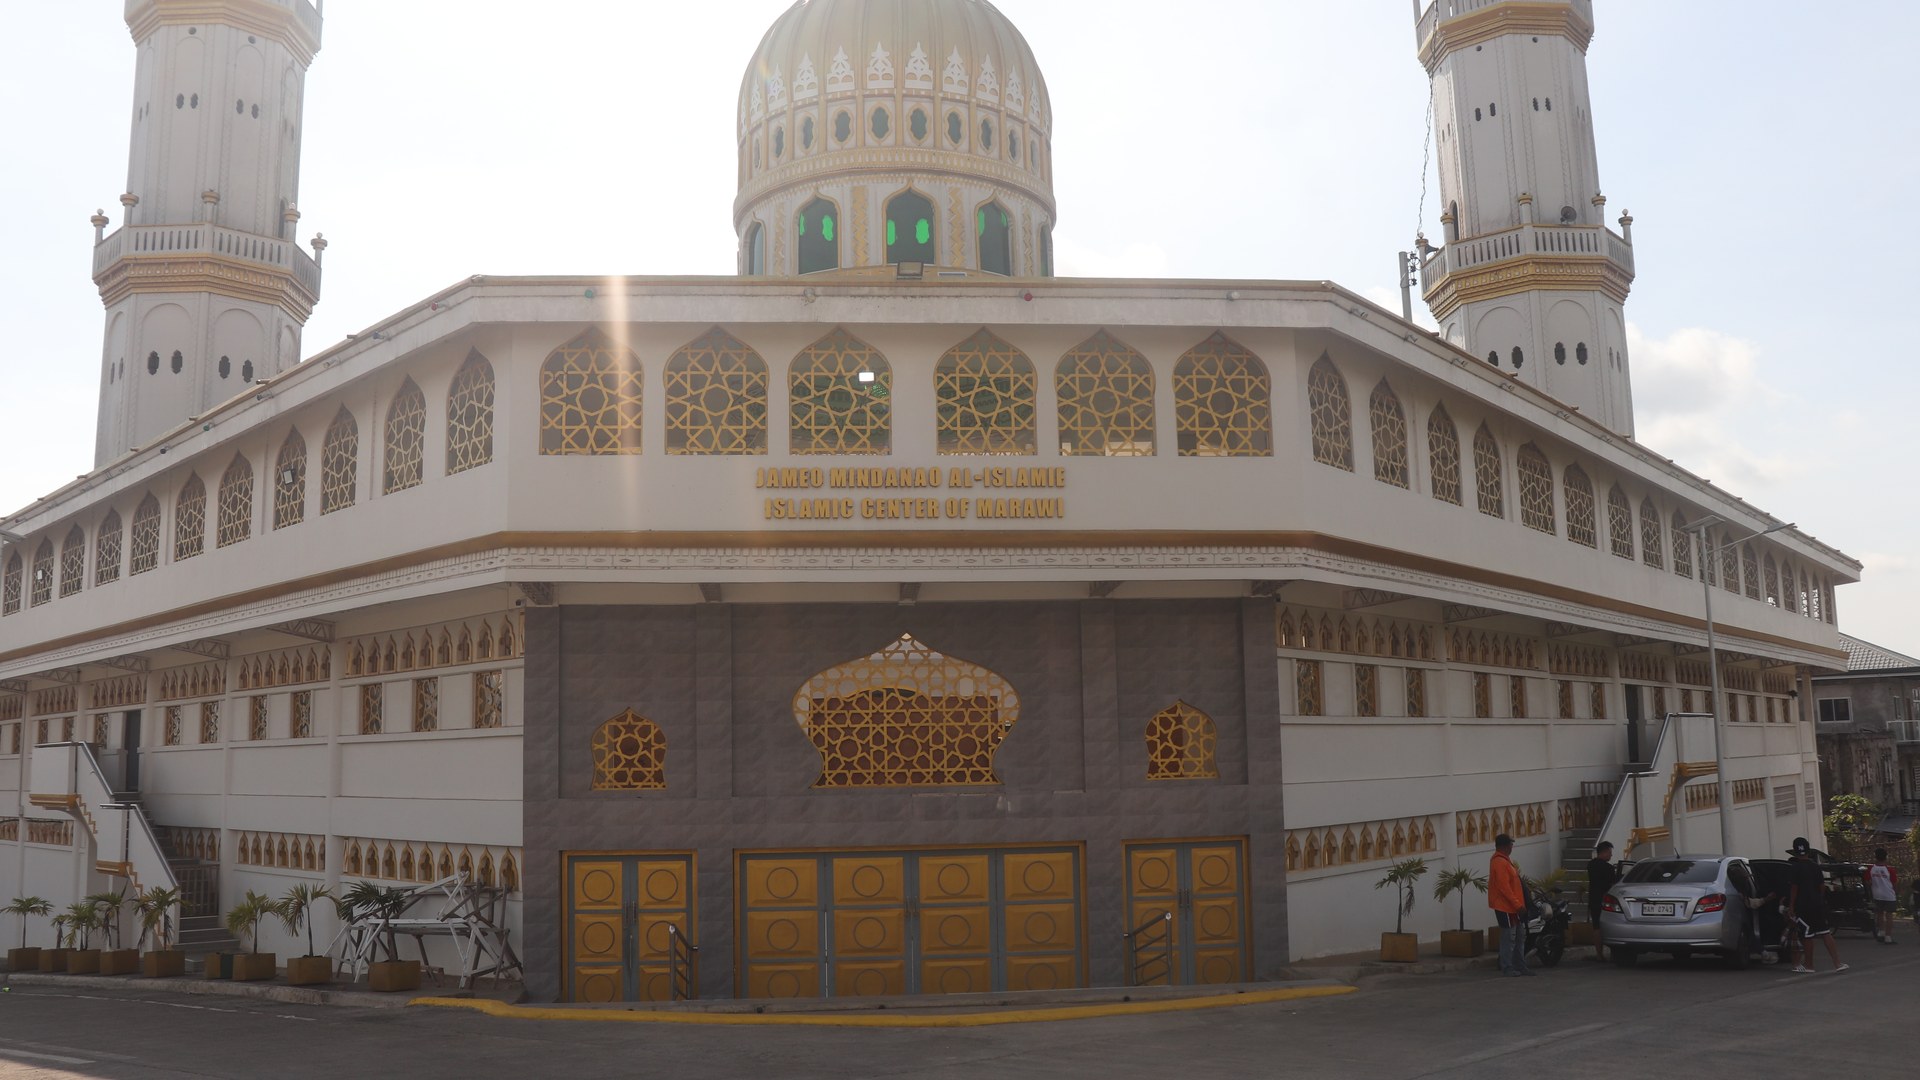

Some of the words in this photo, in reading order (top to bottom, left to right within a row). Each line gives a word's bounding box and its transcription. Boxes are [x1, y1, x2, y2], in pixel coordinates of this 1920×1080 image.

[755, 467, 824, 489] JAMEO
[830, 467, 942, 489] MINDANAO
[948, 467, 1066, 489] AL-ISLAMIE
[763, 497, 854, 520] ISLAMIC
[860, 497, 940, 520] CENTER
[945, 497, 970, 520] OF
[976, 497, 1065, 520] MARAWI
